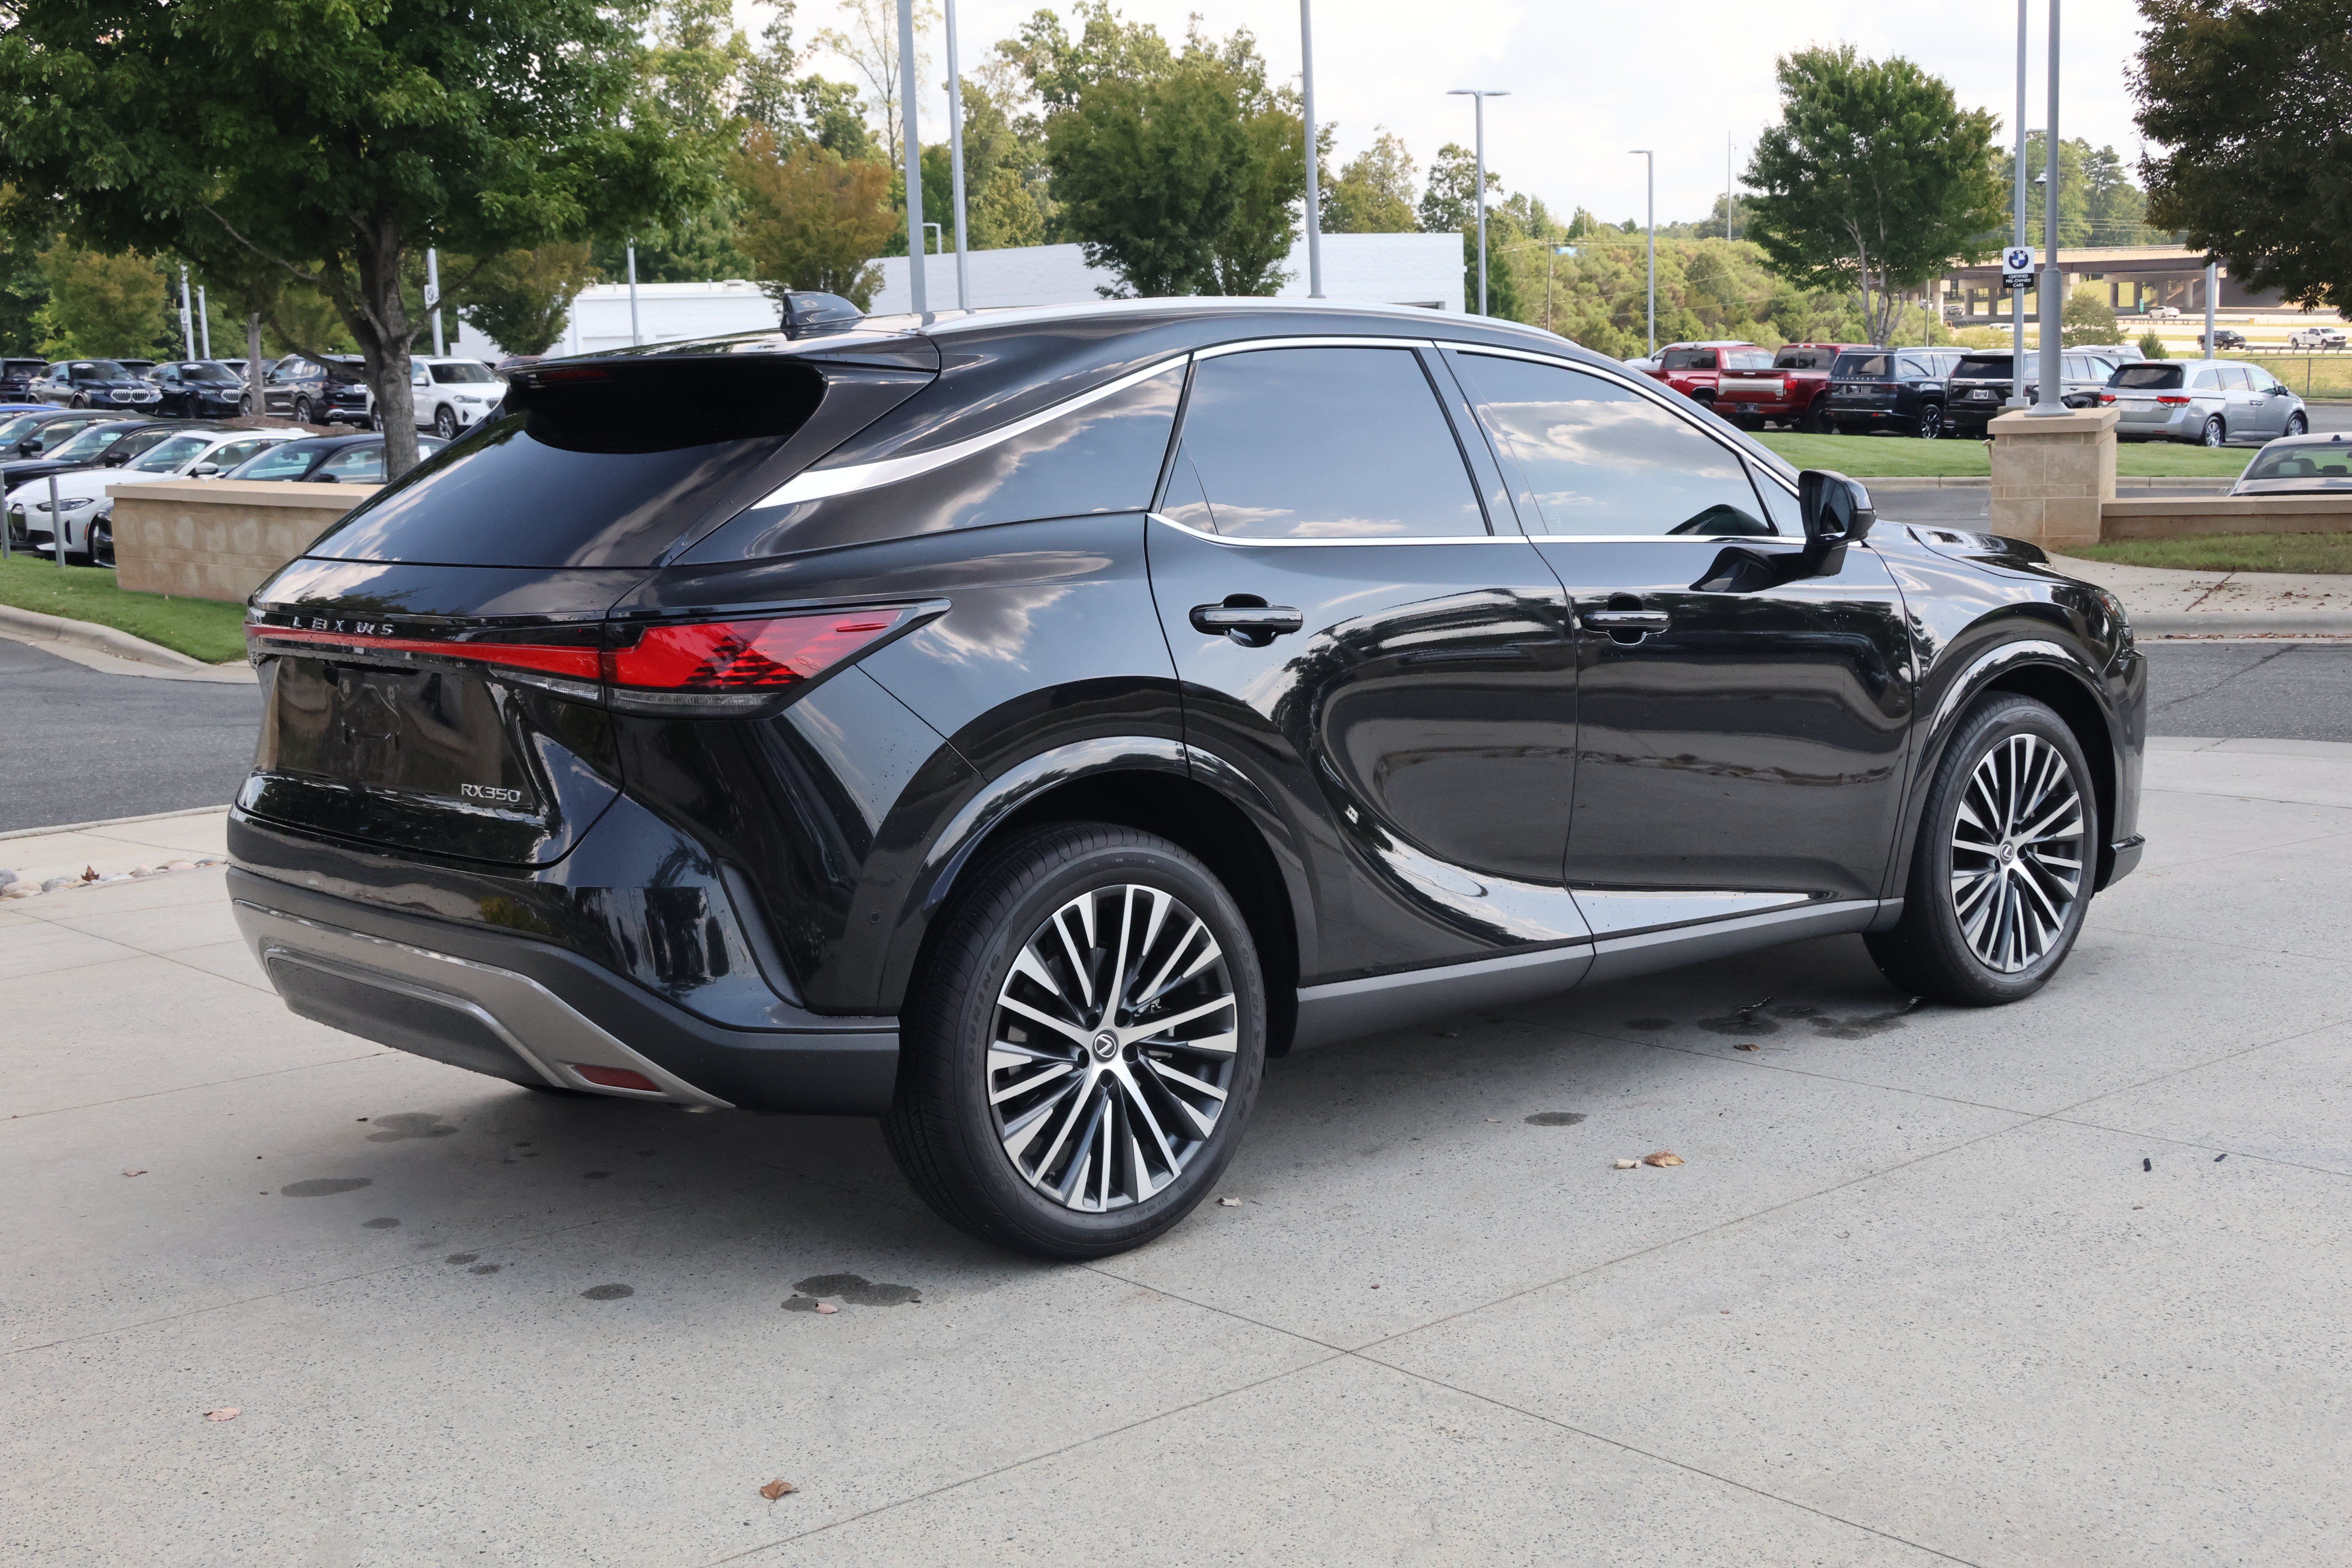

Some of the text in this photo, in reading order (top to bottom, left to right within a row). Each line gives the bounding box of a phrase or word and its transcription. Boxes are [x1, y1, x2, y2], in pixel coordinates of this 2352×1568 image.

[293, 616, 394, 635] LEXUS
[461, 783, 522, 802] RX350
[1231, 926, 1261, 1120] GOODYEAR
